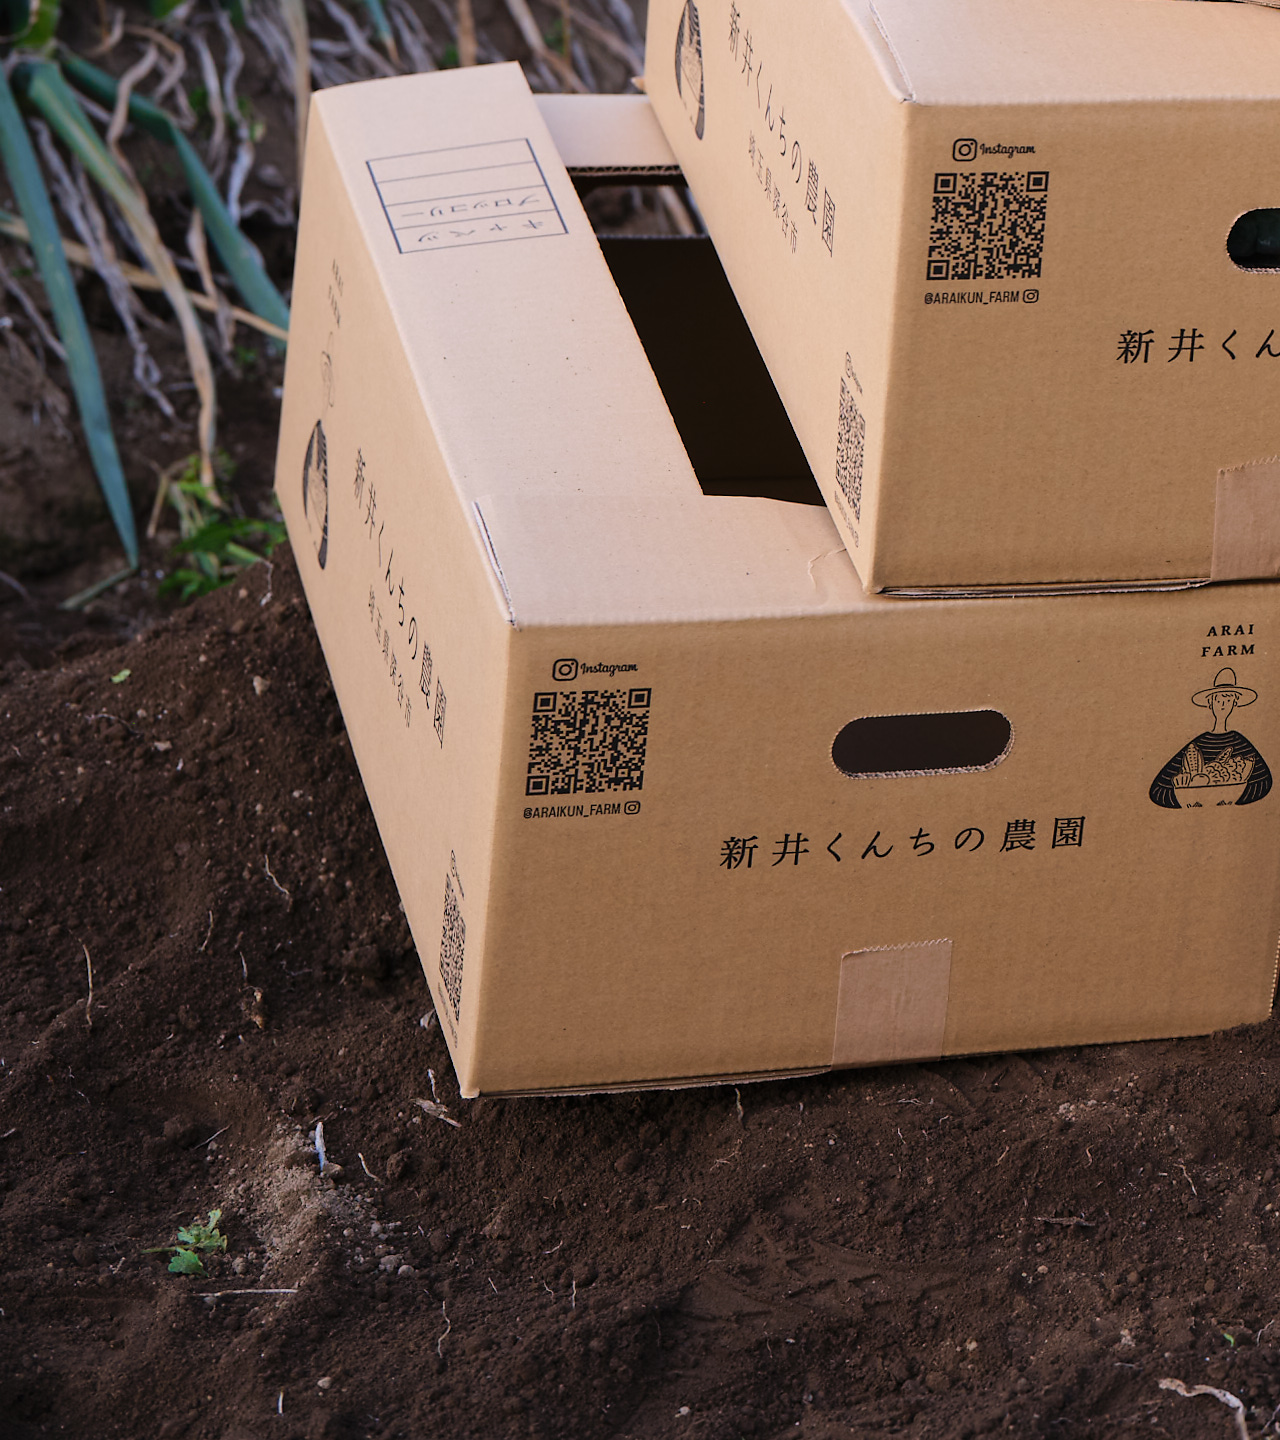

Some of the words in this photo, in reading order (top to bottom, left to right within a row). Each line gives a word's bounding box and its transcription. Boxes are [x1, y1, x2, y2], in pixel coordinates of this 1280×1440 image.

[729, 0, 836, 258] 新井くんちの農園
[979, 142, 1036, 159] Instagram
[1206, 623, 1255, 638] ARAI
[1200, 643, 1255, 658] FARM
[580, 661, 639, 678] Instagram
[719, 815, 1086, 870] 新井くんちの農園
